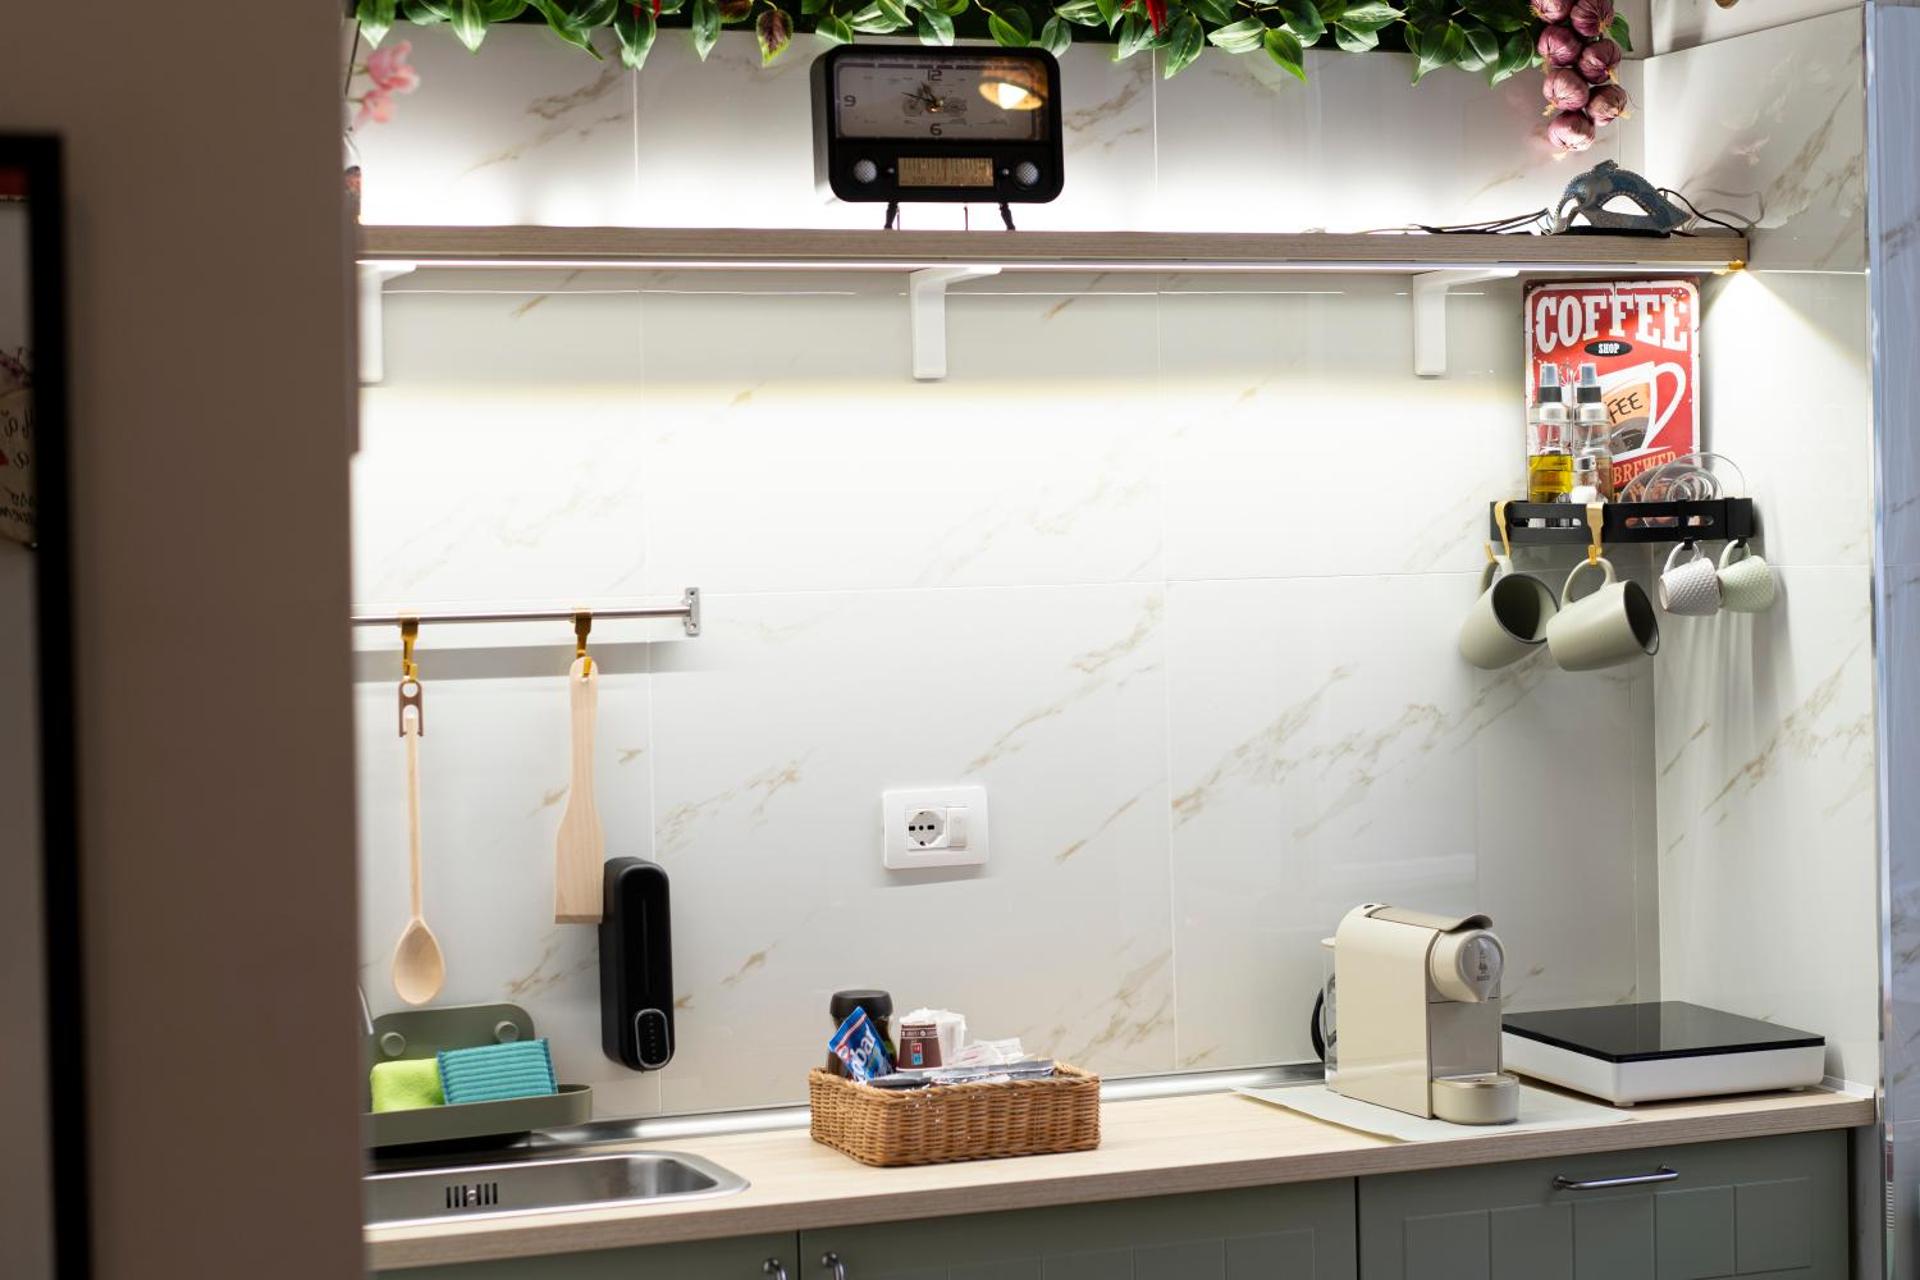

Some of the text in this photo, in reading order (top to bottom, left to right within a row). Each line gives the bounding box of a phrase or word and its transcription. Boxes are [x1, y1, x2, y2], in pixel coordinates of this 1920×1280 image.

[927, 69, 943, 82] 12
[844, 95, 856, 107] 9
[930, 123, 942, 136] 6
[1536, 294, 1687, 353] COFFEE
[1598, 343, 1620, 354] SHOP
[1606, 392, 1643, 423] FEE
[850, 1022, 876, 1082] obar
